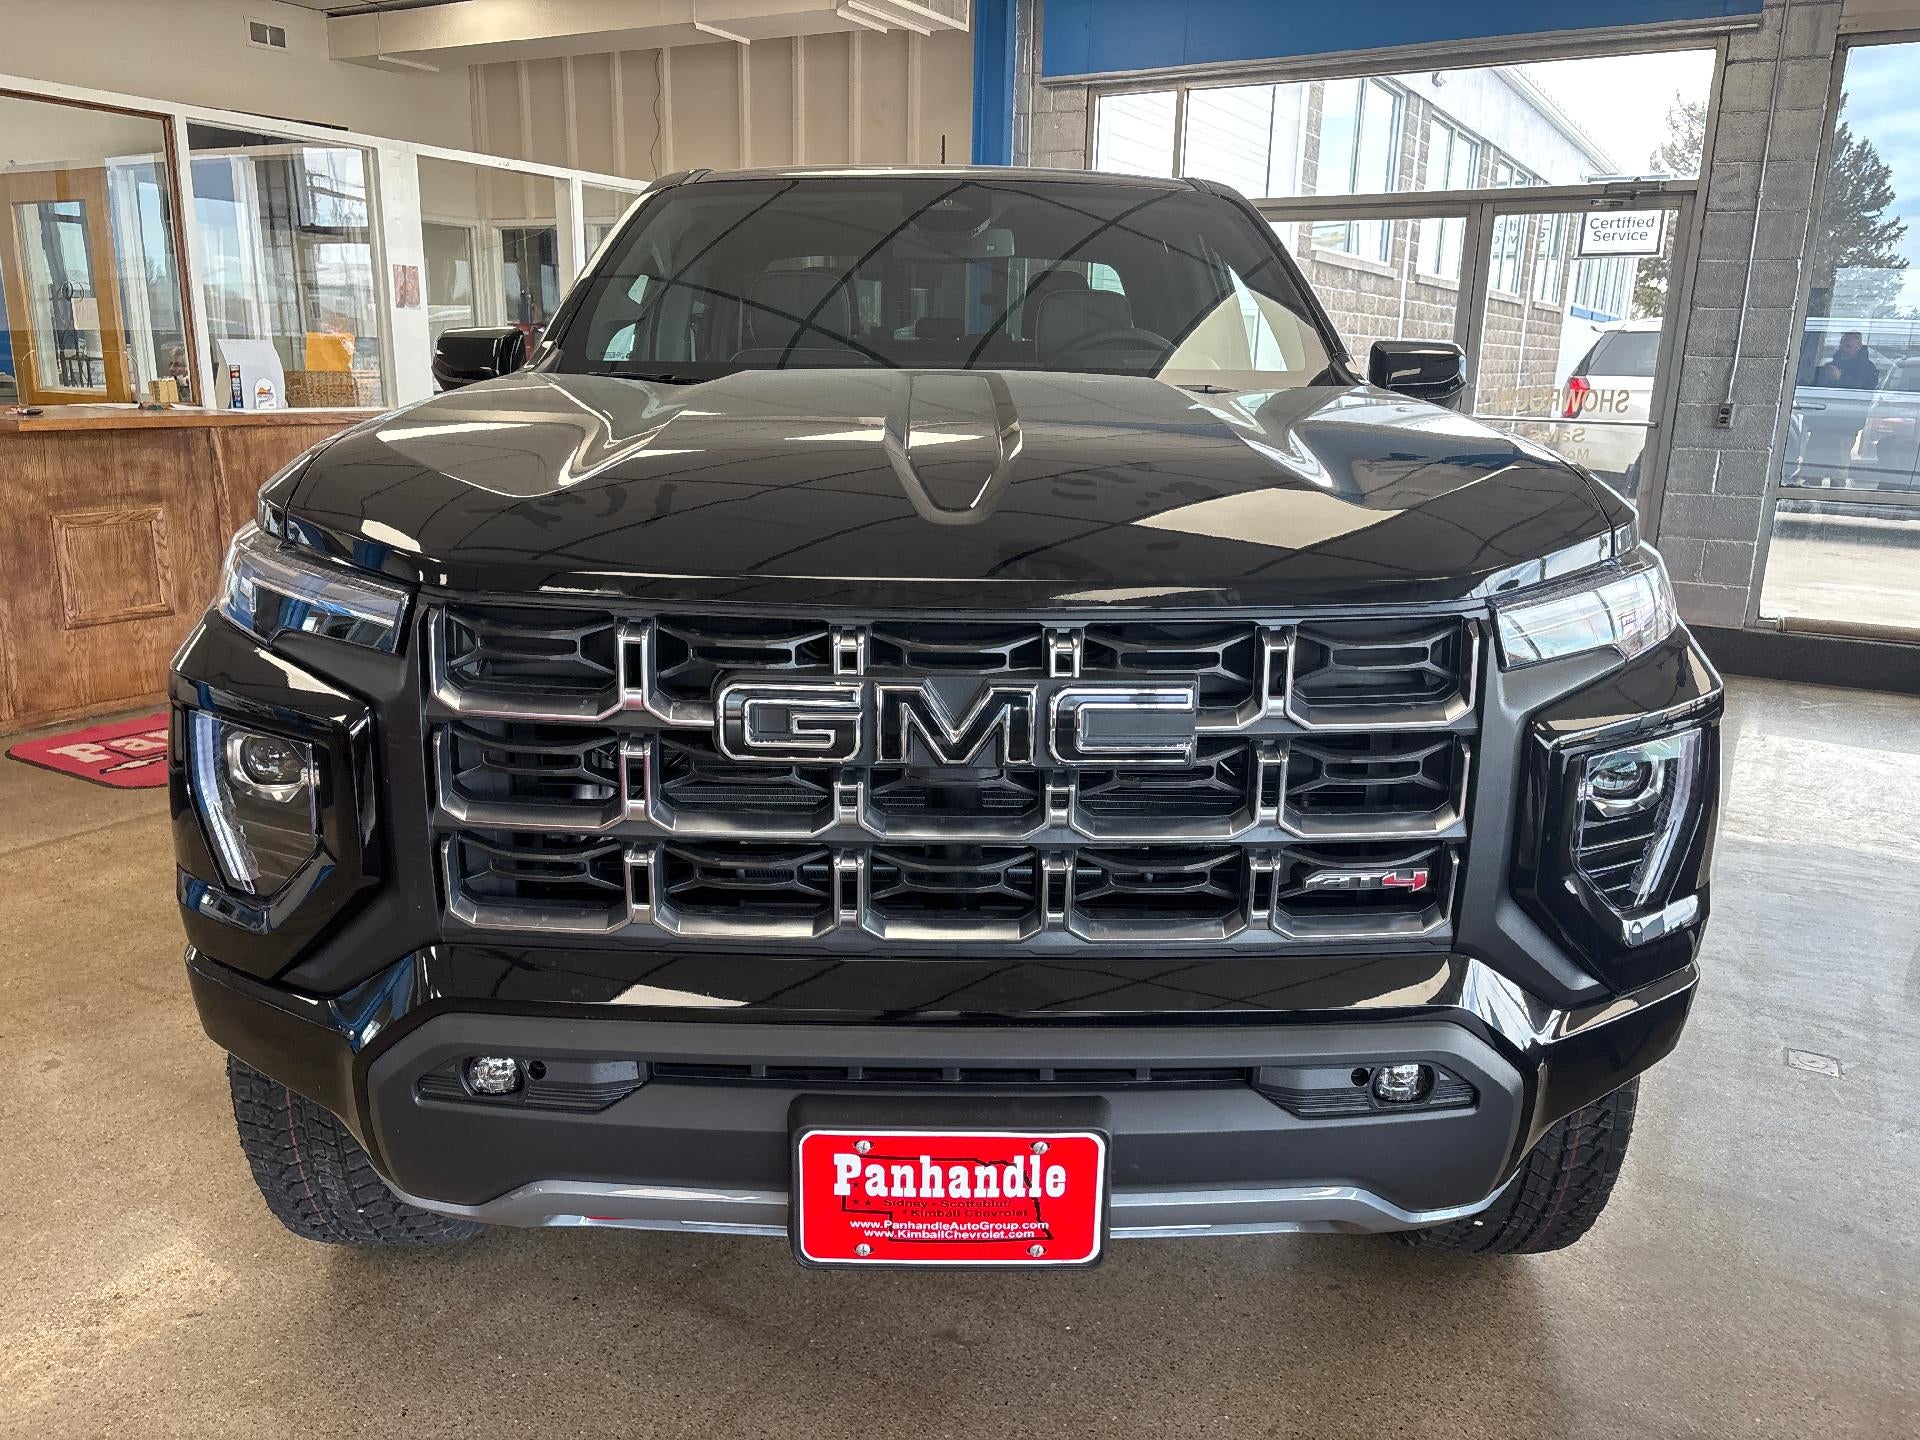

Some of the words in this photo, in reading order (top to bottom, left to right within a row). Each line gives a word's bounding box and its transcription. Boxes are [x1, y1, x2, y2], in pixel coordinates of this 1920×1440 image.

[1590, 215, 1655, 230] Certified
[1593, 230, 1649, 242] Service
[715, 678, 1197, 767] GMC
[1304, 869, 1429, 893] AT4
[833, 1153, 1066, 1199] Panhandle
[884, 1199, 928, 1208] Sidney
[940, 1199, 1012, 1208] Scottsbluff
[910, 1209, 960, 1218] Kimball
[964, 1209, 1028, 1218] Chevrolet
[849, 1220, 1049, 1231] www.PanhandleAutoGroup.com
[863, 1229, 1035, 1239] www.KimballChevrolet.com
